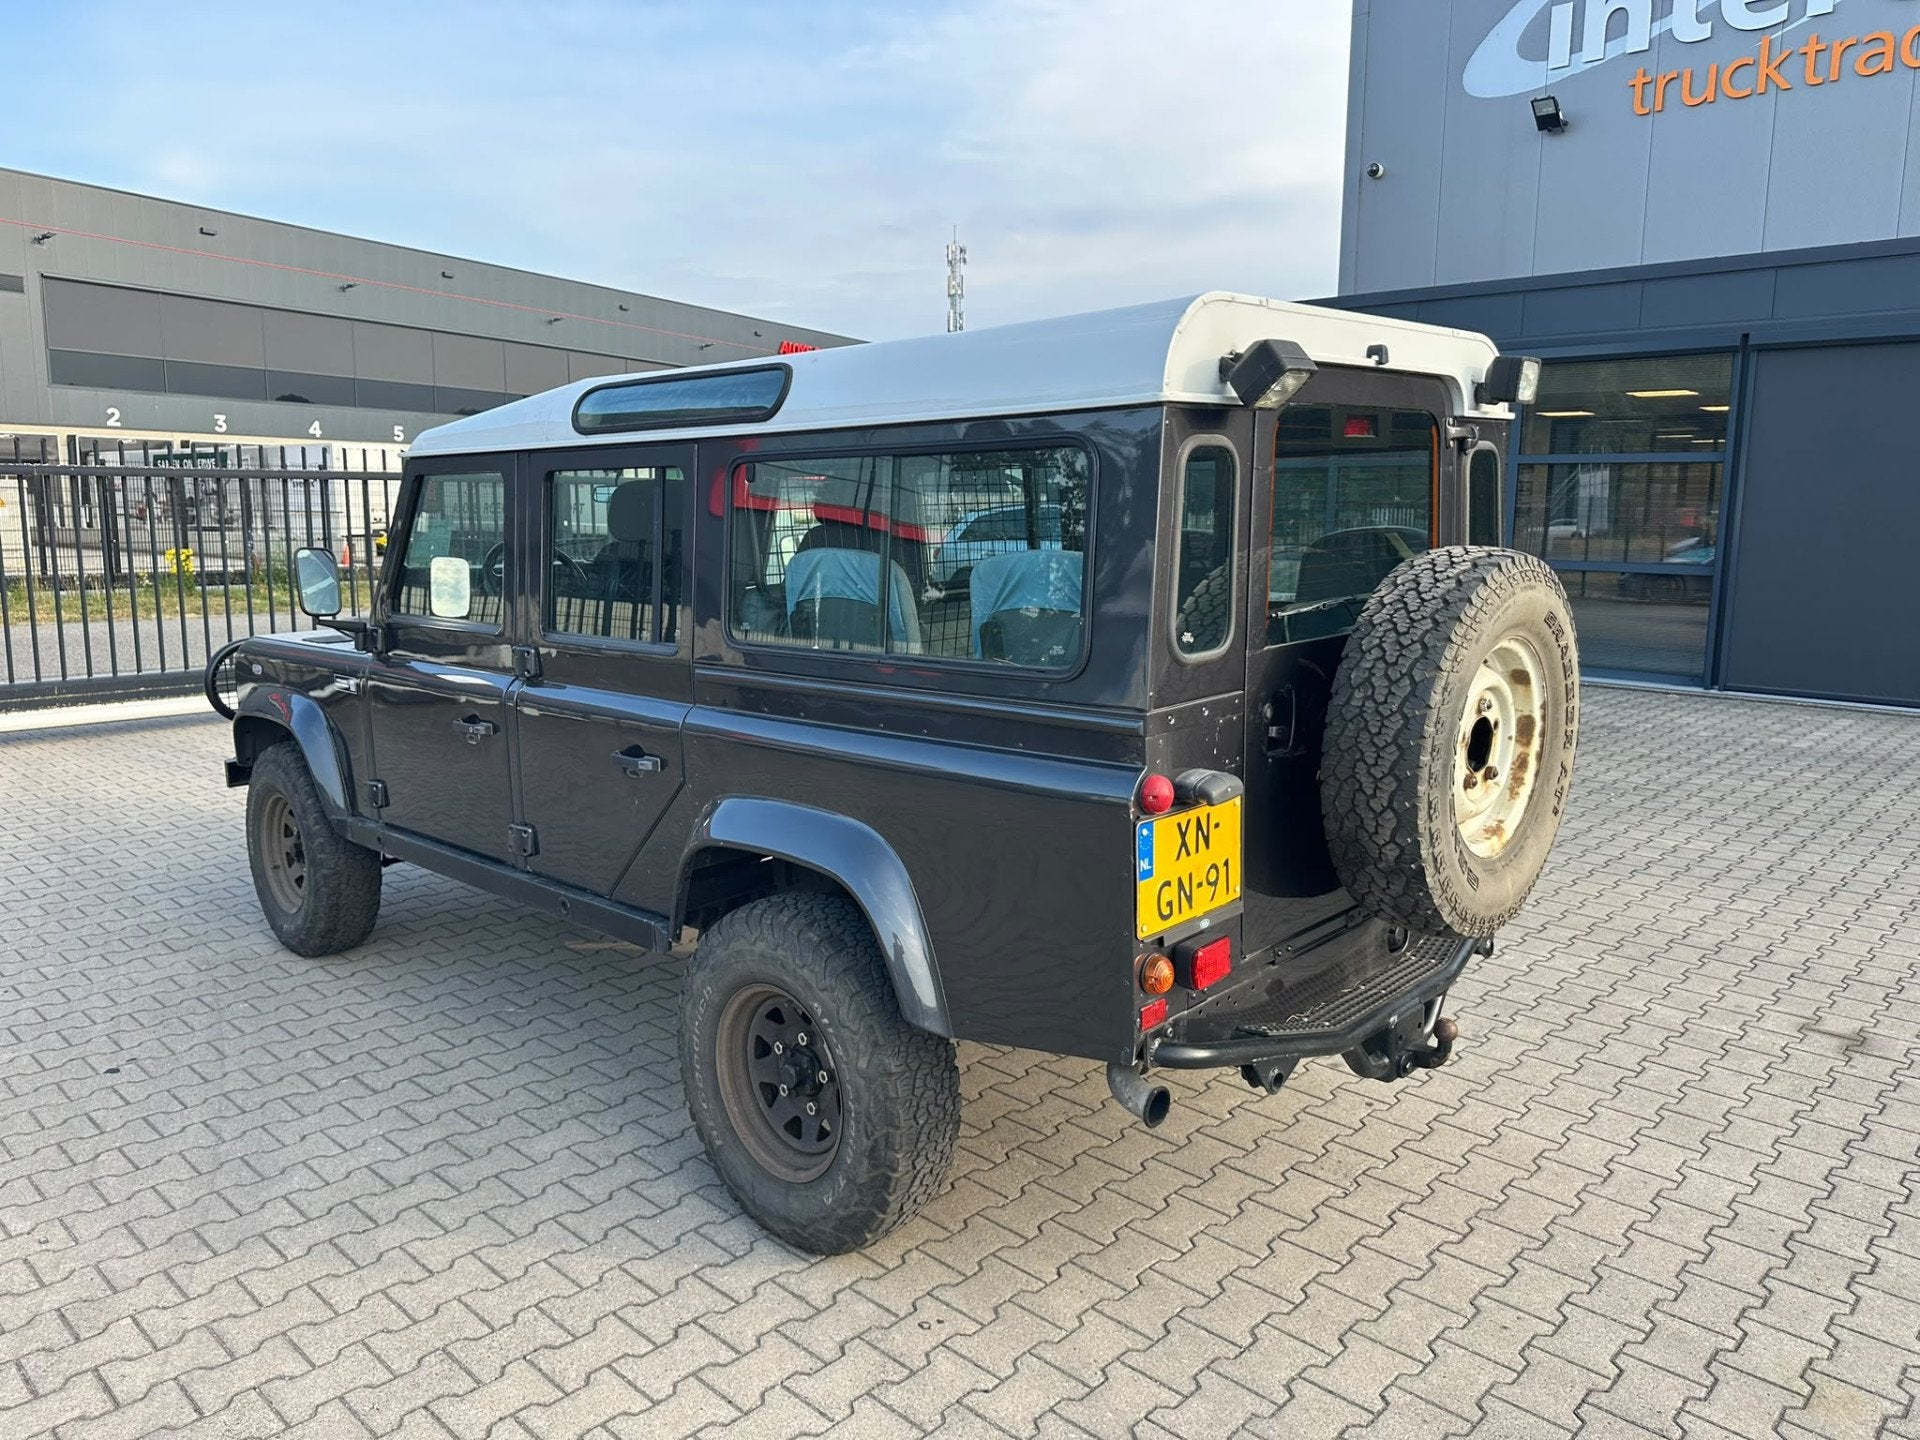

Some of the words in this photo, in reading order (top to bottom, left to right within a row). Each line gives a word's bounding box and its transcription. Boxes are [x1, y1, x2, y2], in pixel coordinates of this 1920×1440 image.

[106, 407, 121, 427] 2
[214, 414, 228, 433] 3
[308, 420, 322, 438] 4
[393, 426, 404, 442] 5
[1175, 811, 1221, 862] XN-
[1140, 856, 1152, 872] NL
[1156, 858, 1231, 922] GN-91
